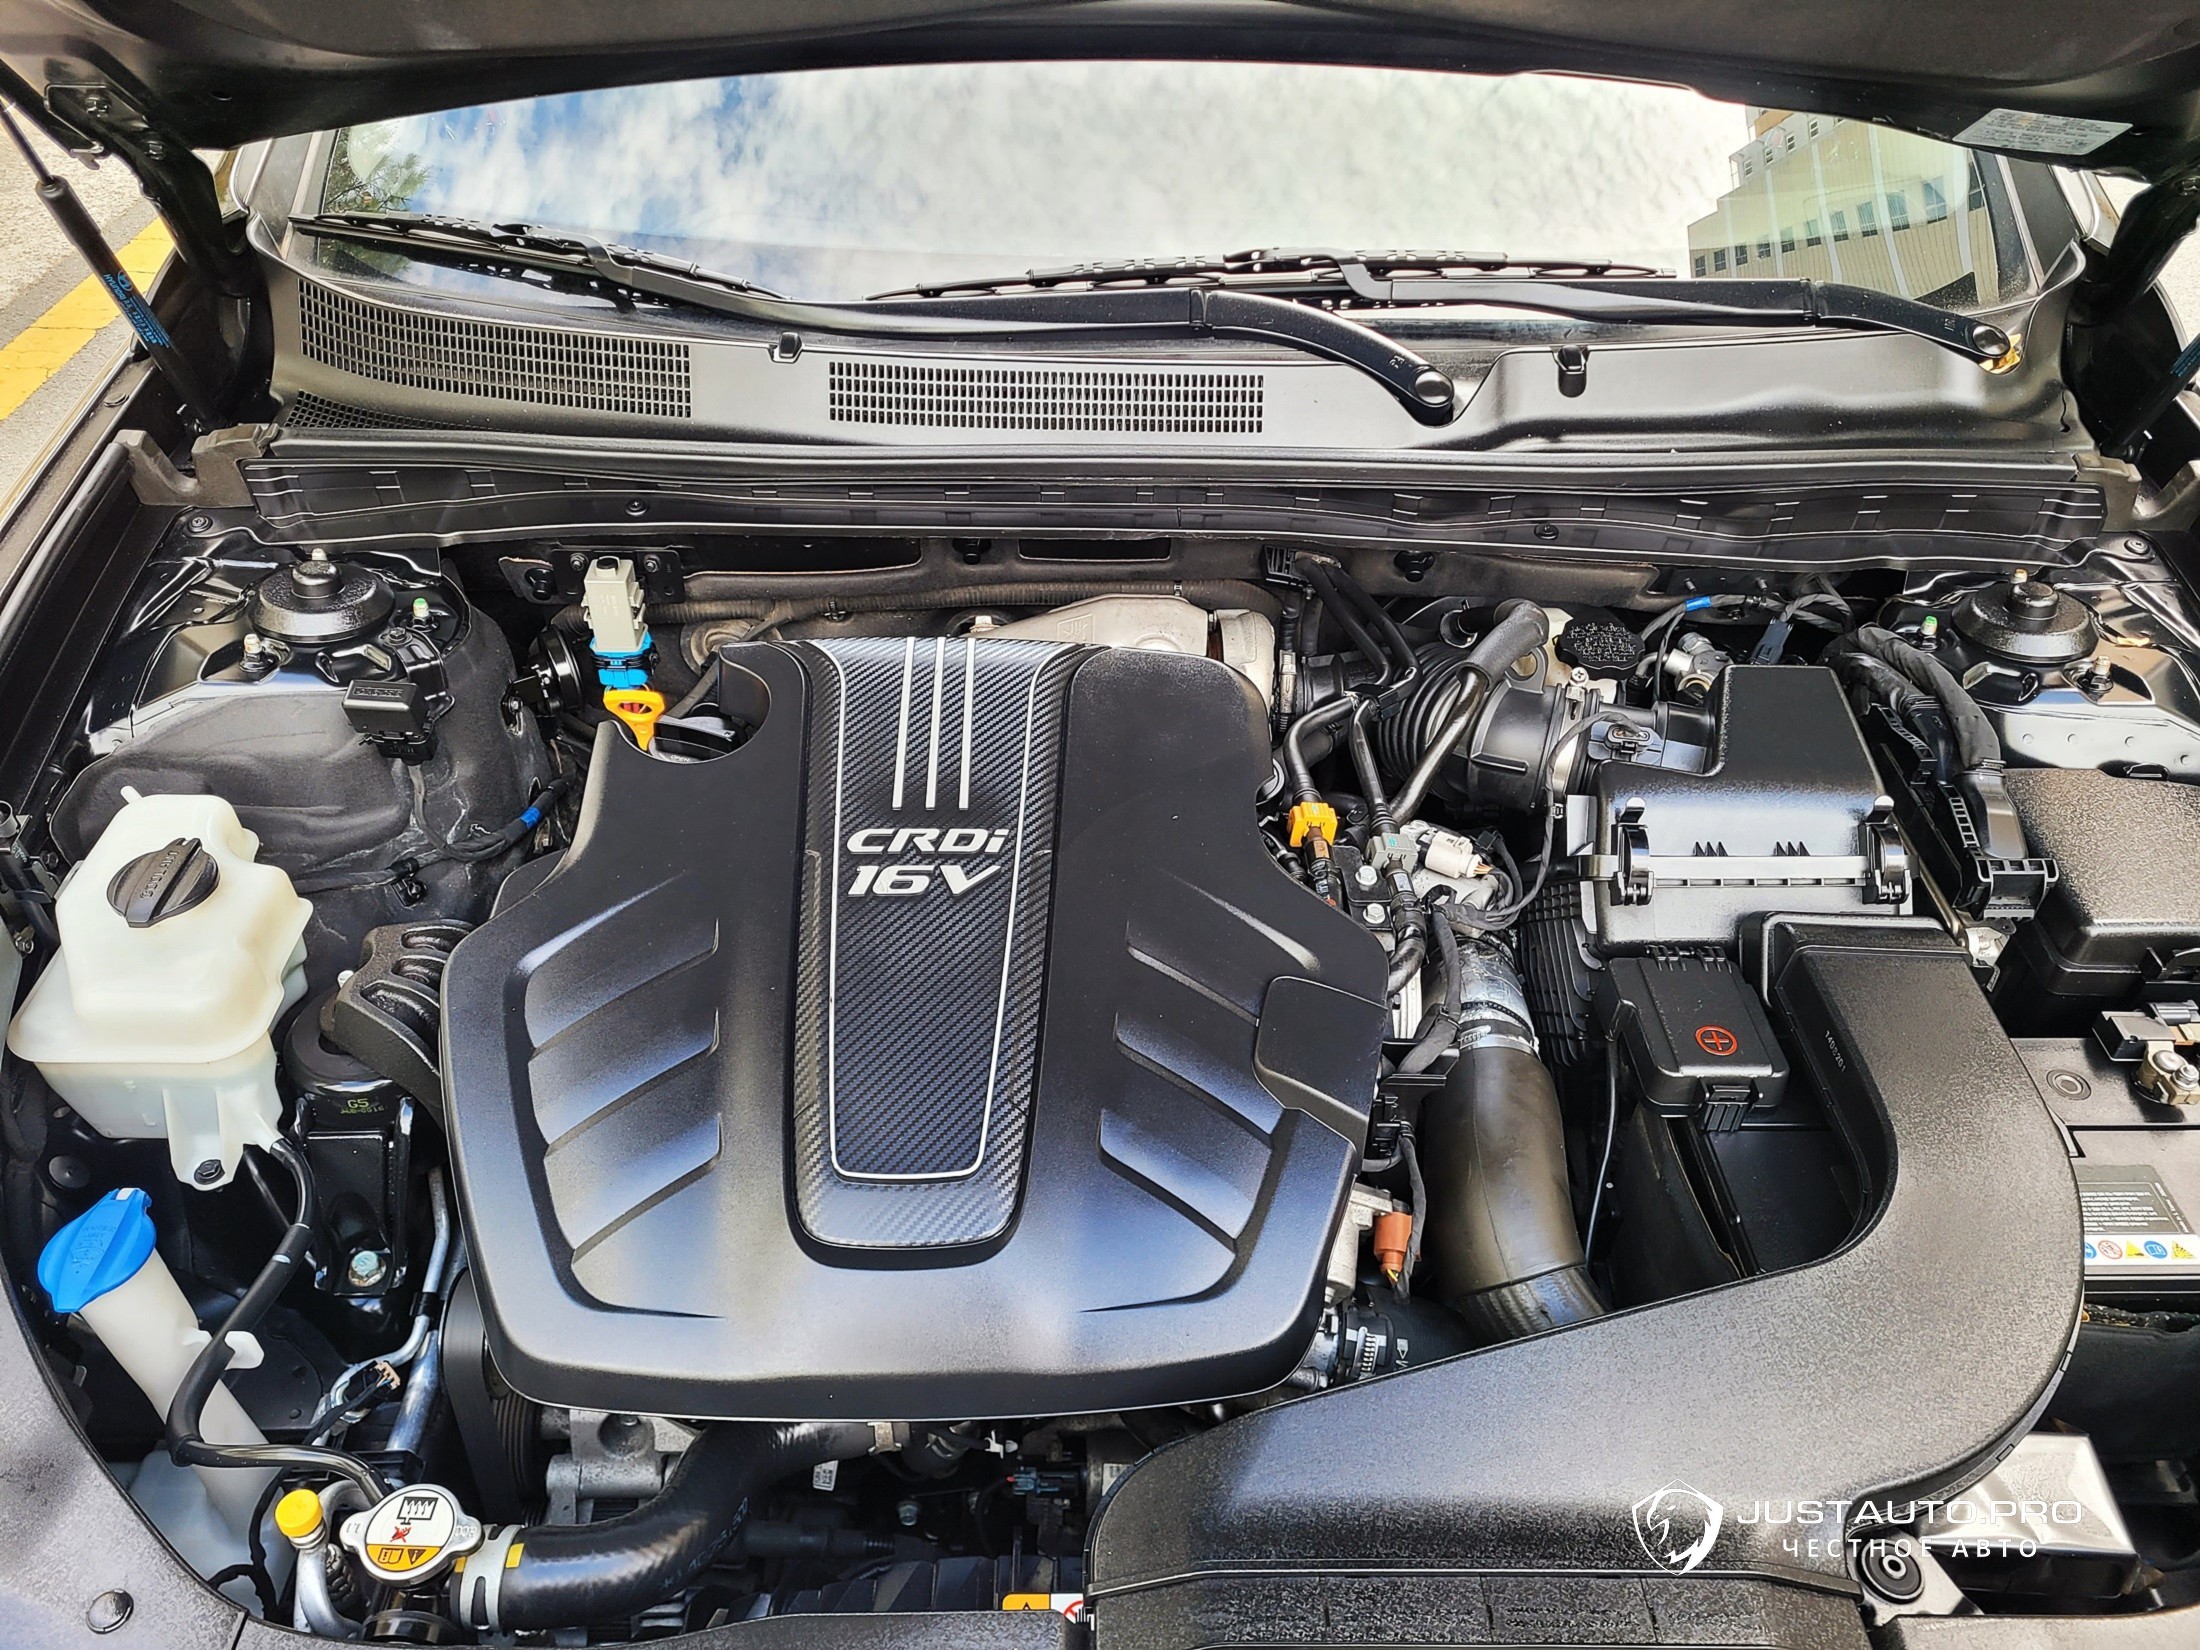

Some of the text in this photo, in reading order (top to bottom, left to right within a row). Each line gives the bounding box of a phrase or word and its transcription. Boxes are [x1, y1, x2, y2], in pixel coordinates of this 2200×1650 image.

[846, 828, 1010, 855] CRDi
[847, 865, 1002, 897] 16V
[347, 1098, 370, 1109] G5
